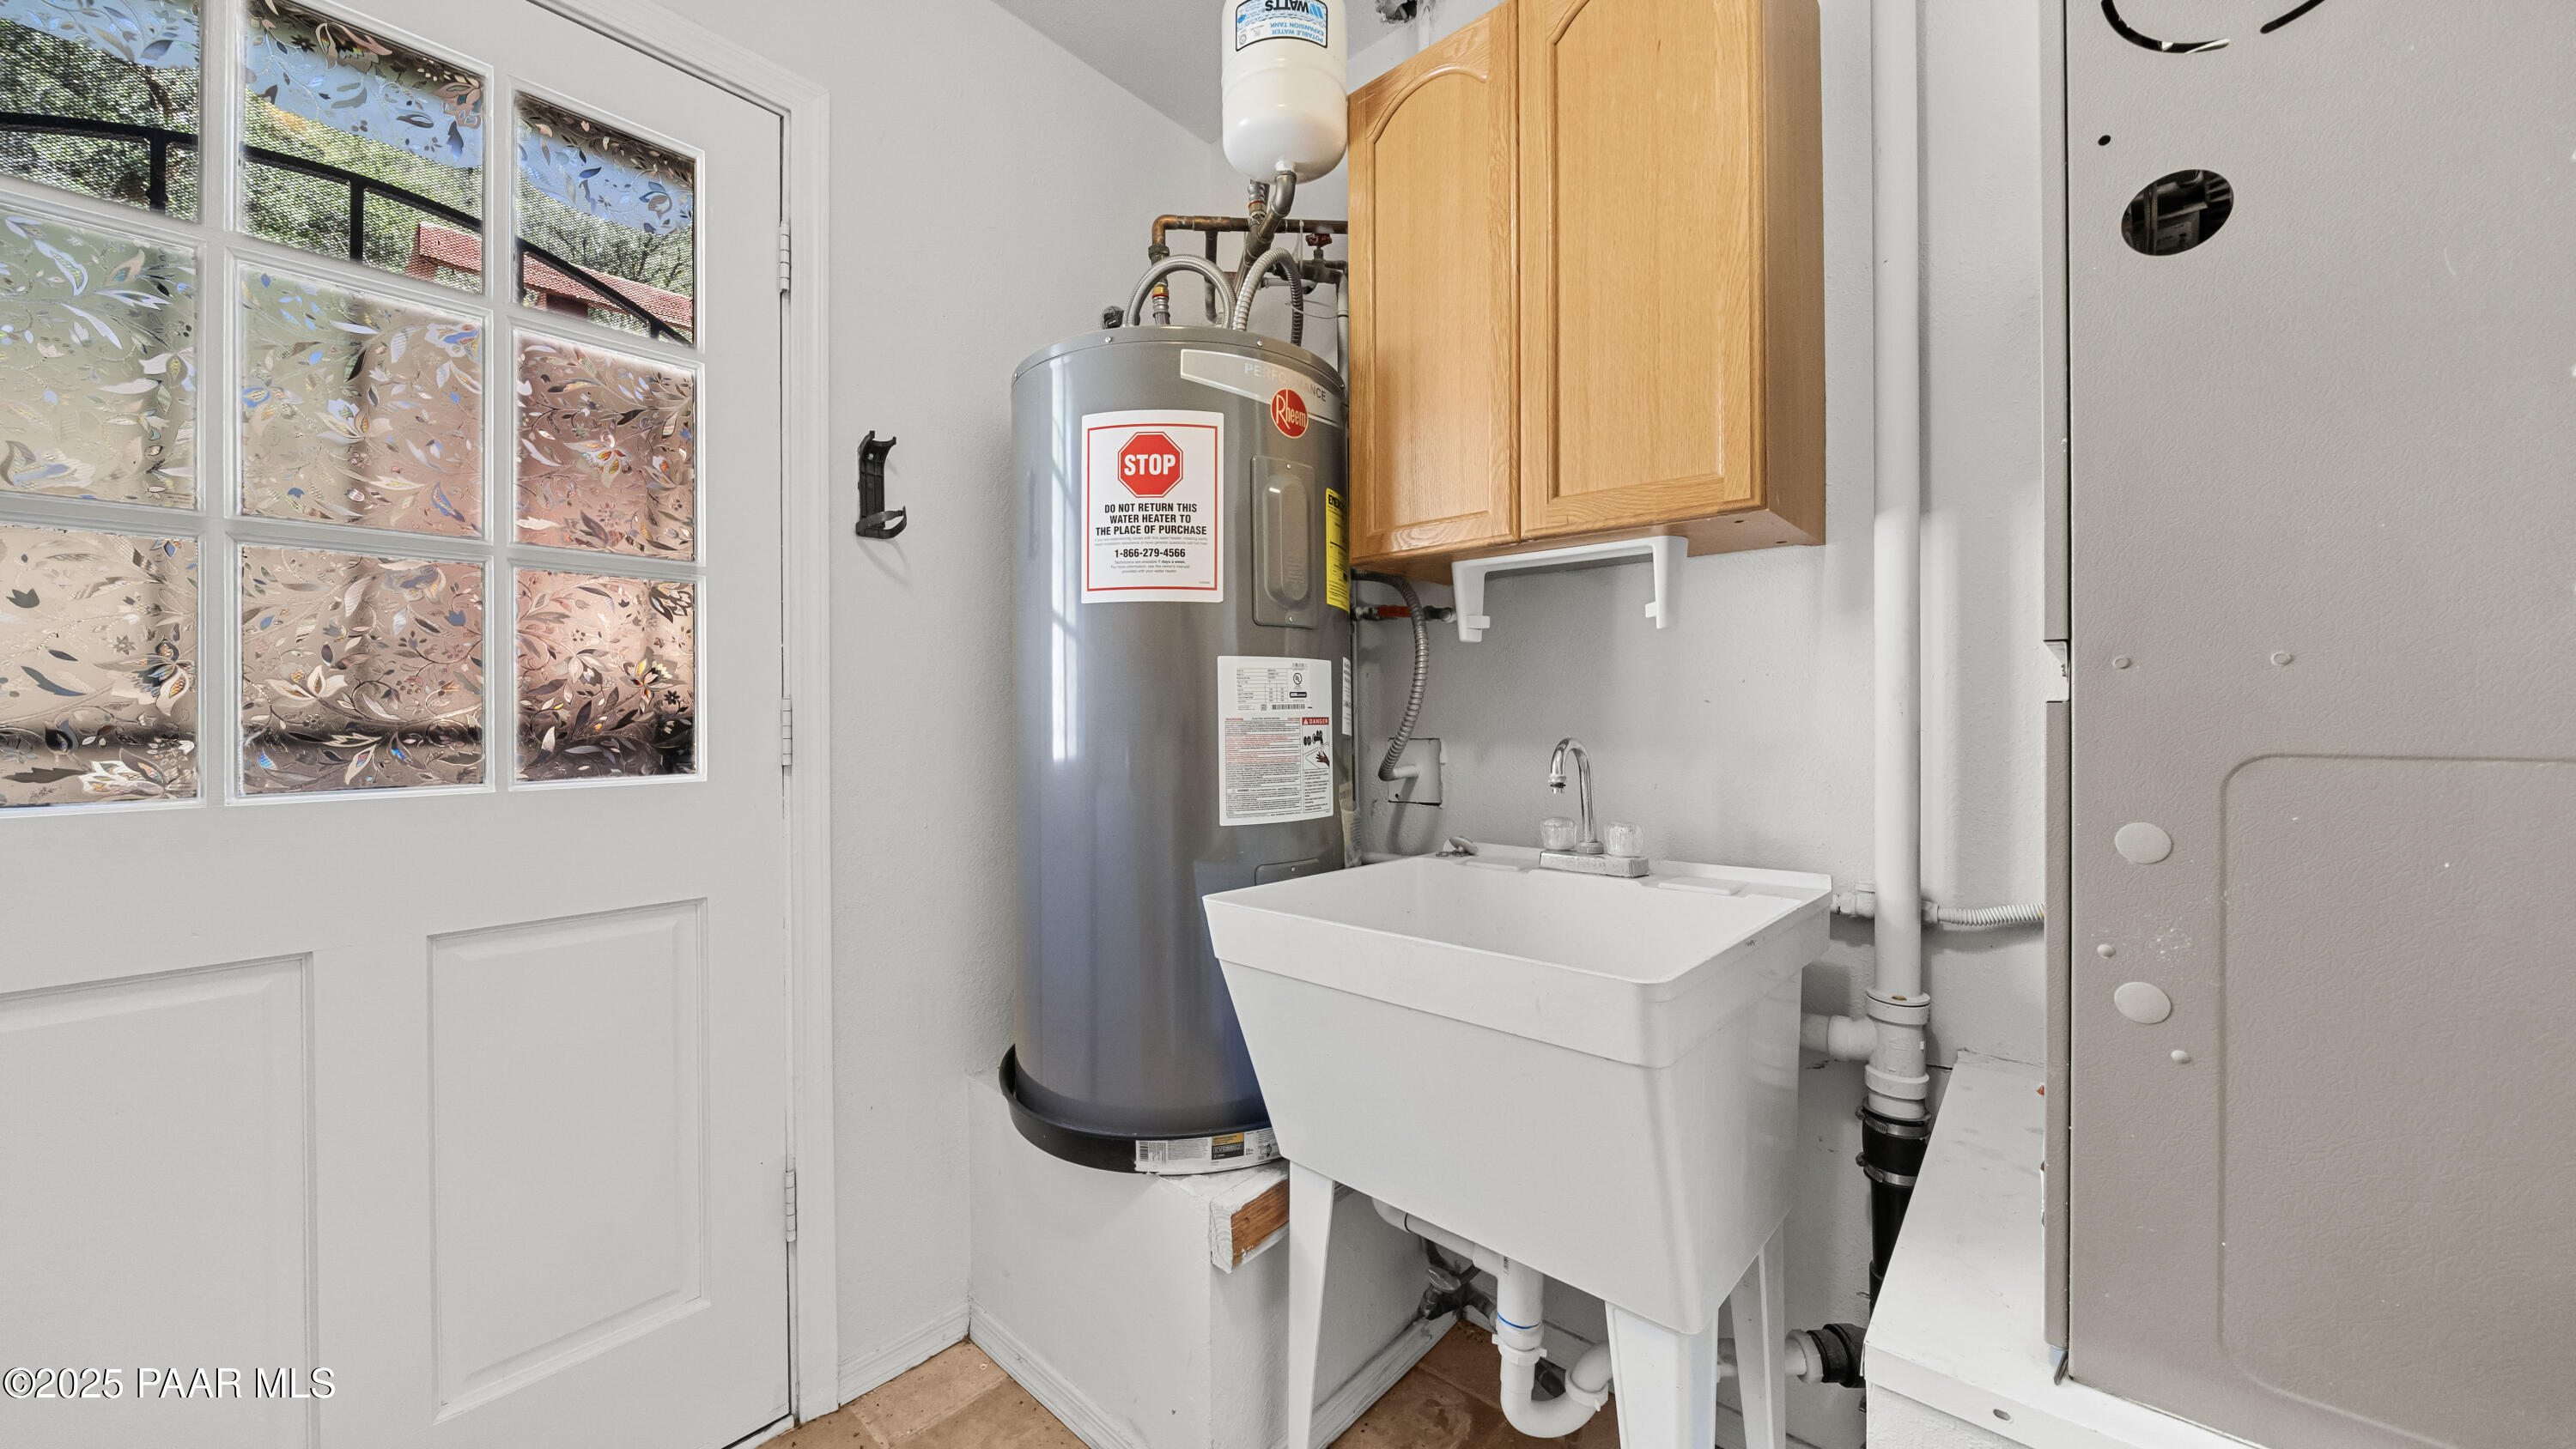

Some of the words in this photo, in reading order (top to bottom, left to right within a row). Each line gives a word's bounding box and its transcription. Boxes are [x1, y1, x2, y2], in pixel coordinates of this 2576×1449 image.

[1265, 0, 1309, 13] WATTS
[1289, 22, 1324, 36] EXPANSION
[1296, 29, 1324, 43] POTABLE
[1245, 362, 1327, 403] PERFOANCE
[1276, 389, 1307, 429] Rheem
[1124, 453, 1176, 476] STOP
[1104, 504, 1117, 513] DO
[1118, 503, 1135, 512] NOT
[1138, 503, 1173, 512] RETURN
[1176, 503, 1197, 512] THIS
[1109, 515, 1139, 524] WATER
[1142, 514, 1176, 524] HEATER
[1180, 514, 1191, 524] TO
[1096, 527, 1111, 536] THE
[1114, 525, 1141, 535] PLACE
[1144, 525, 1156, 534] OF
[1159, 525, 1206, 535] PURCHASE
[1115, 548, 1186, 558] 1-866-279-4566
